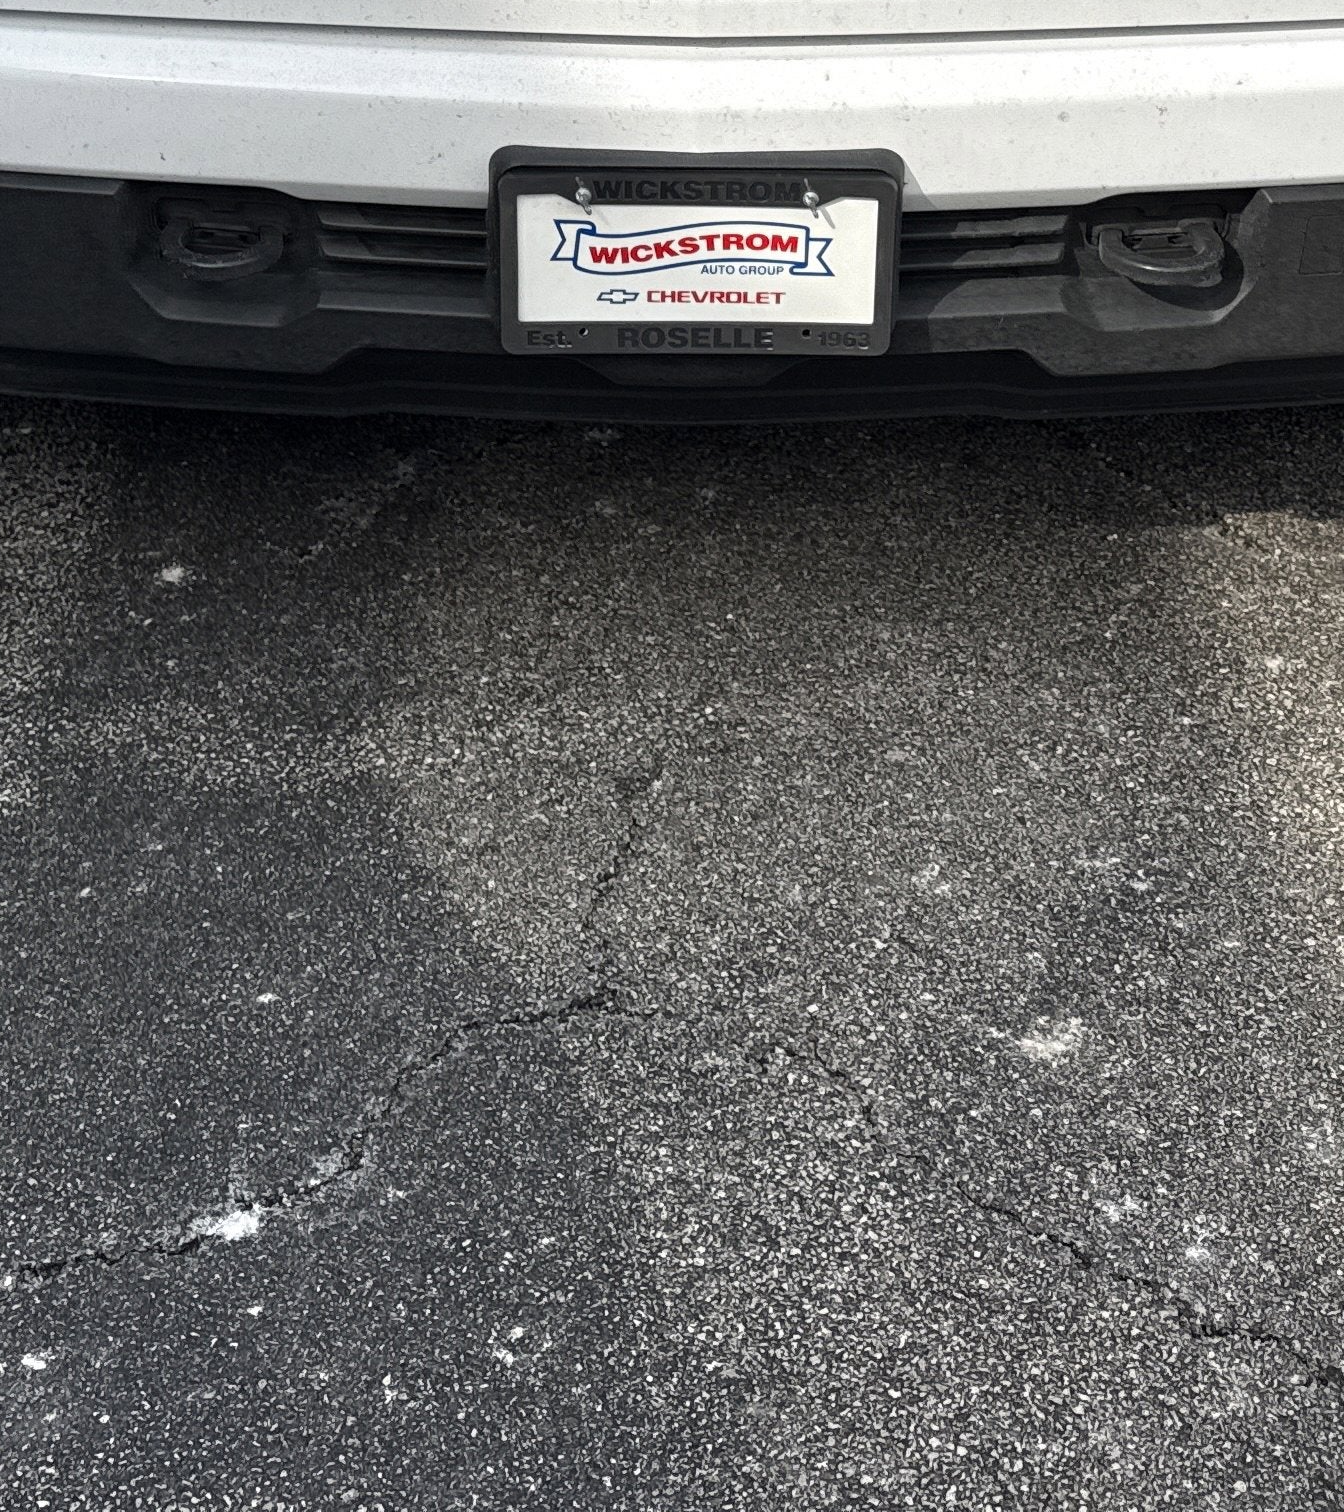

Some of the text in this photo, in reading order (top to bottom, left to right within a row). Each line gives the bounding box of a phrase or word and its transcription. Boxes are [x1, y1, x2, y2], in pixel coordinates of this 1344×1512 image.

[592, 179, 802, 202] WICKSTROM
[589, 234, 798, 264] WICKSTROM
[700, 264, 784, 276] AUTO GROUP
[647, 290, 786, 304] CHEVROLET
[527, 327, 871, 350] Est. ROSELLE 1963
